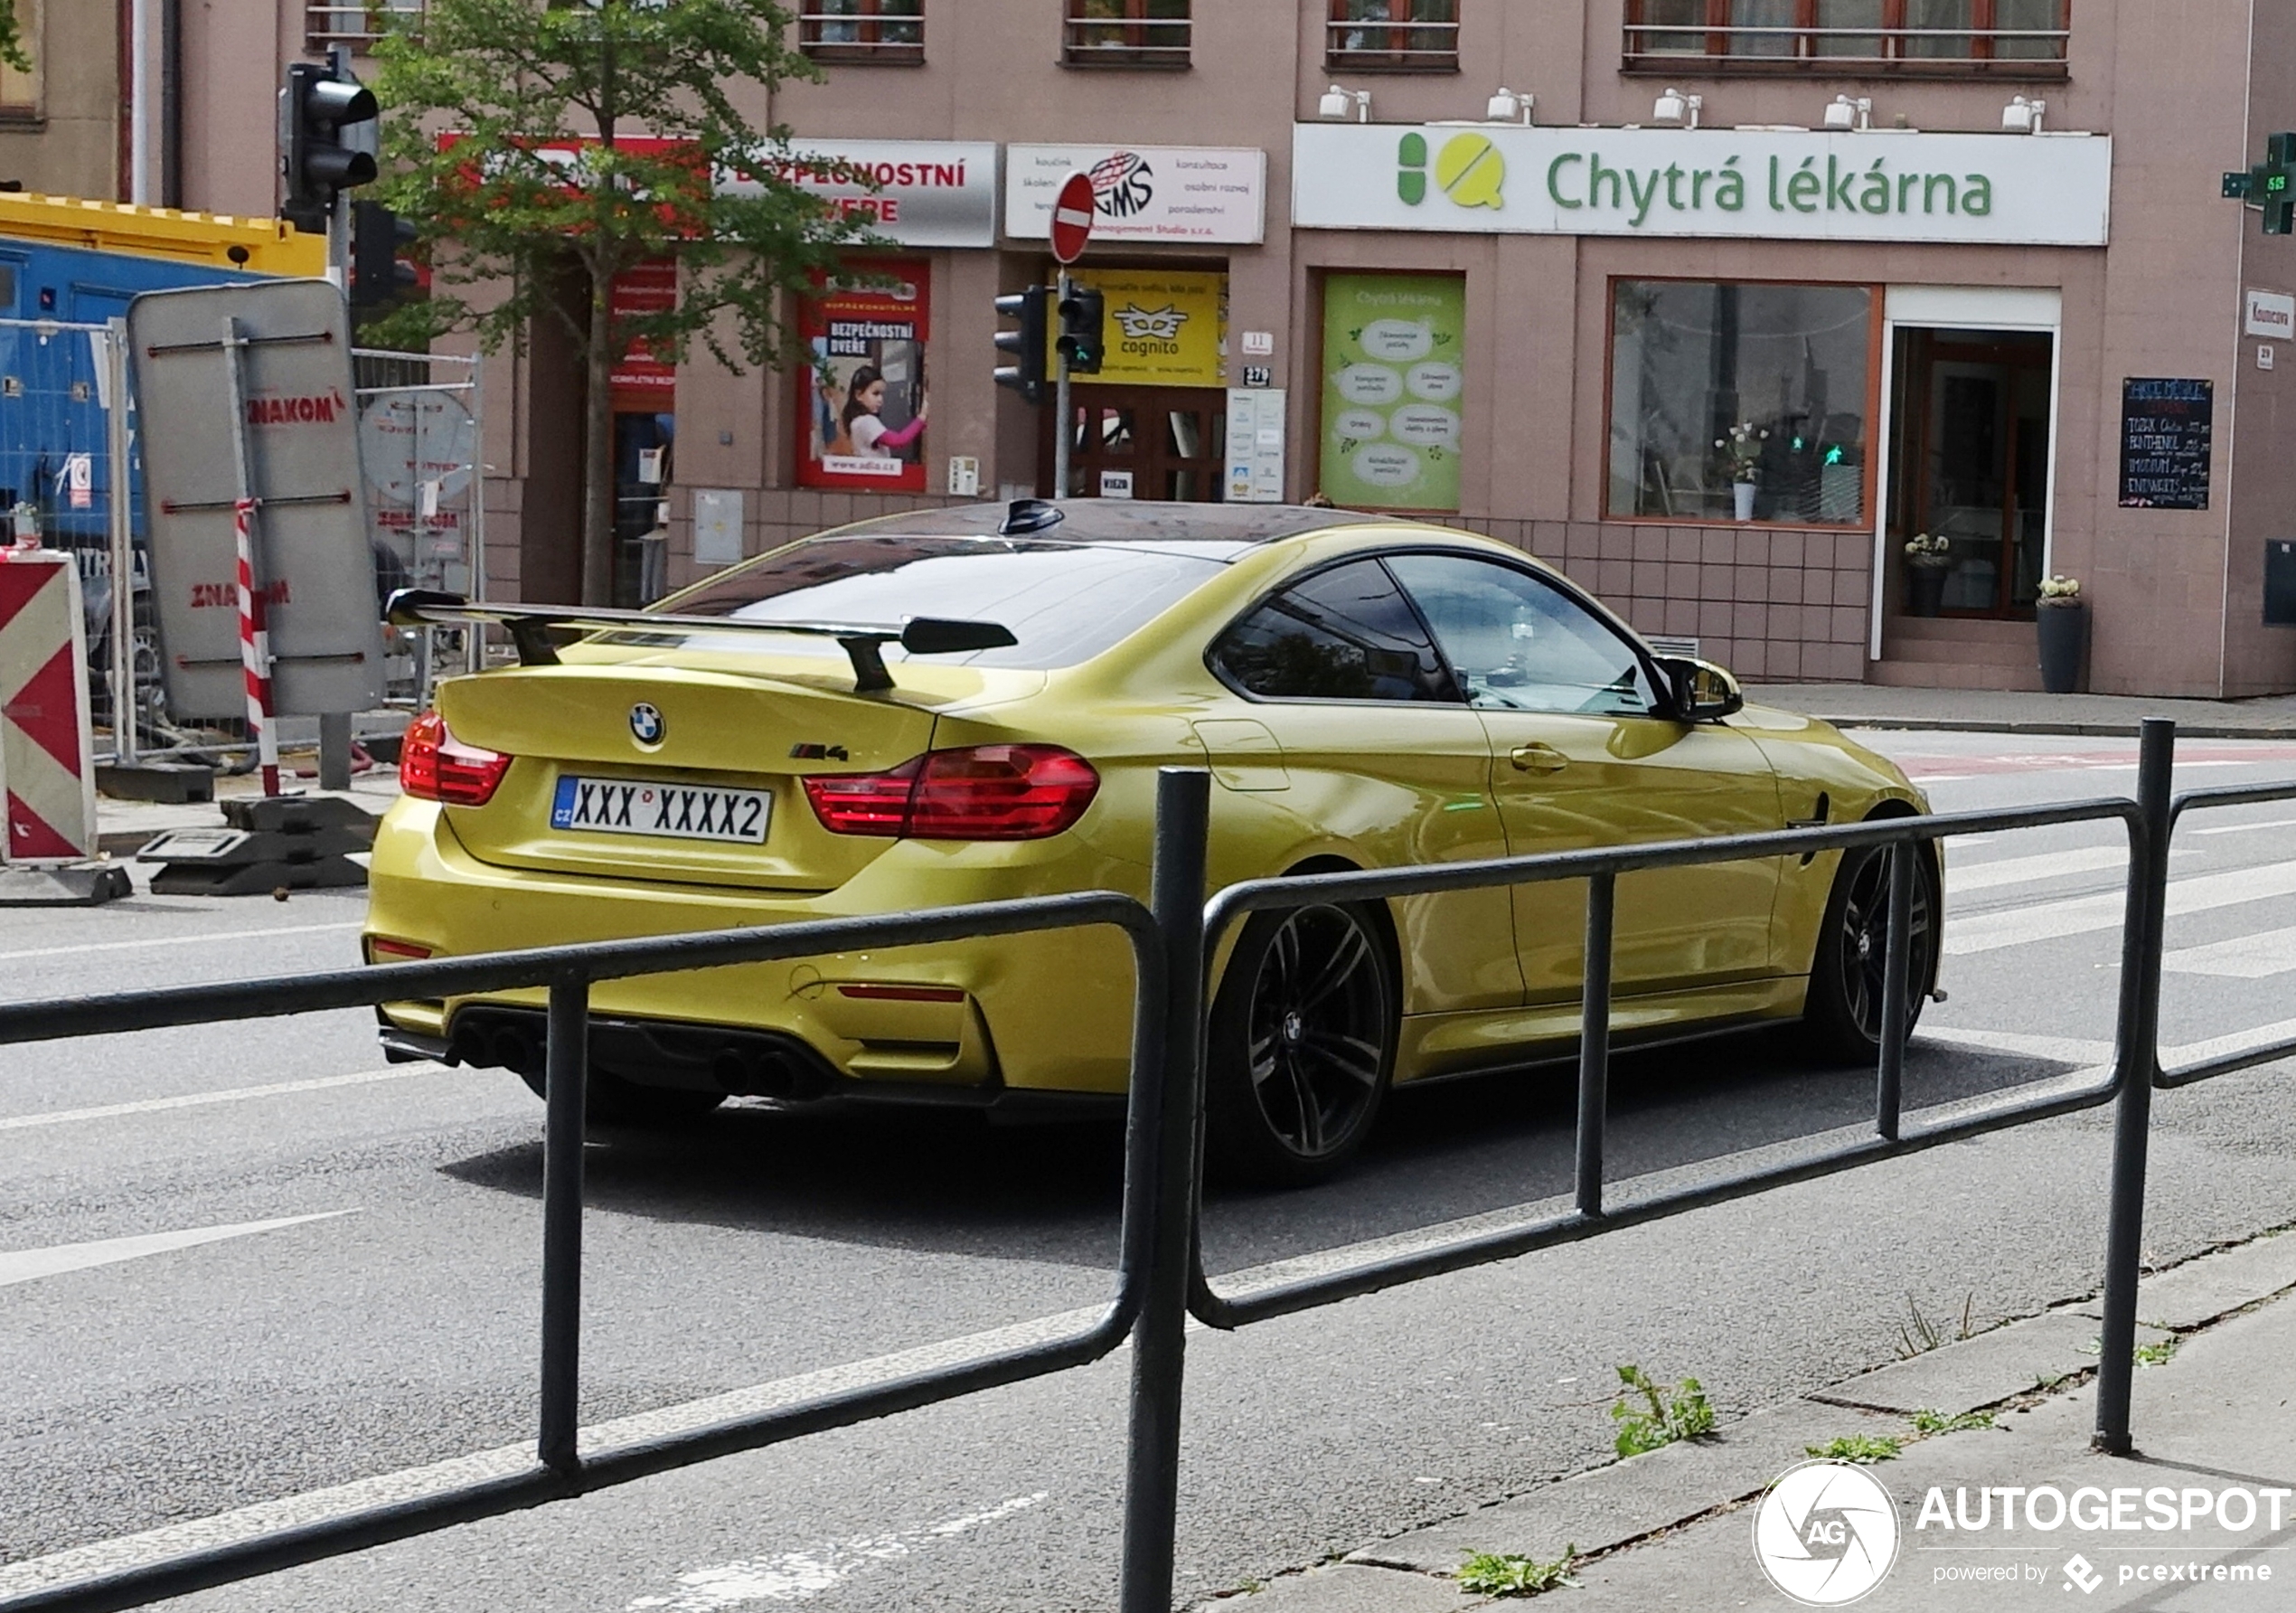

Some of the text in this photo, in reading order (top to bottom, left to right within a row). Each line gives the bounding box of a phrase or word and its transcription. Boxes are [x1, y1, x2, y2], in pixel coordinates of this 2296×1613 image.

[1035, 156, 1072, 166] koučink
[1176, 158, 1228, 170] konzultace
[736, 156, 966, 187] BZPEČNOSTNÍ
[1184, 183, 1217, 192] osobní
[1547, 153, 1991, 227] Chytrá lékárna
[822, 193, 899, 222] VEŘE
[1156, 225, 1188, 235] Studio
[831, 321, 914, 338] BEZPEČNOSTNÍ
[830, 338, 866, 354] DVEŘE
[1121, 339, 1179, 356] cognito
[555, 809, 571, 822] CZ
[574, 783, 762, 837] XXX XXXX2
